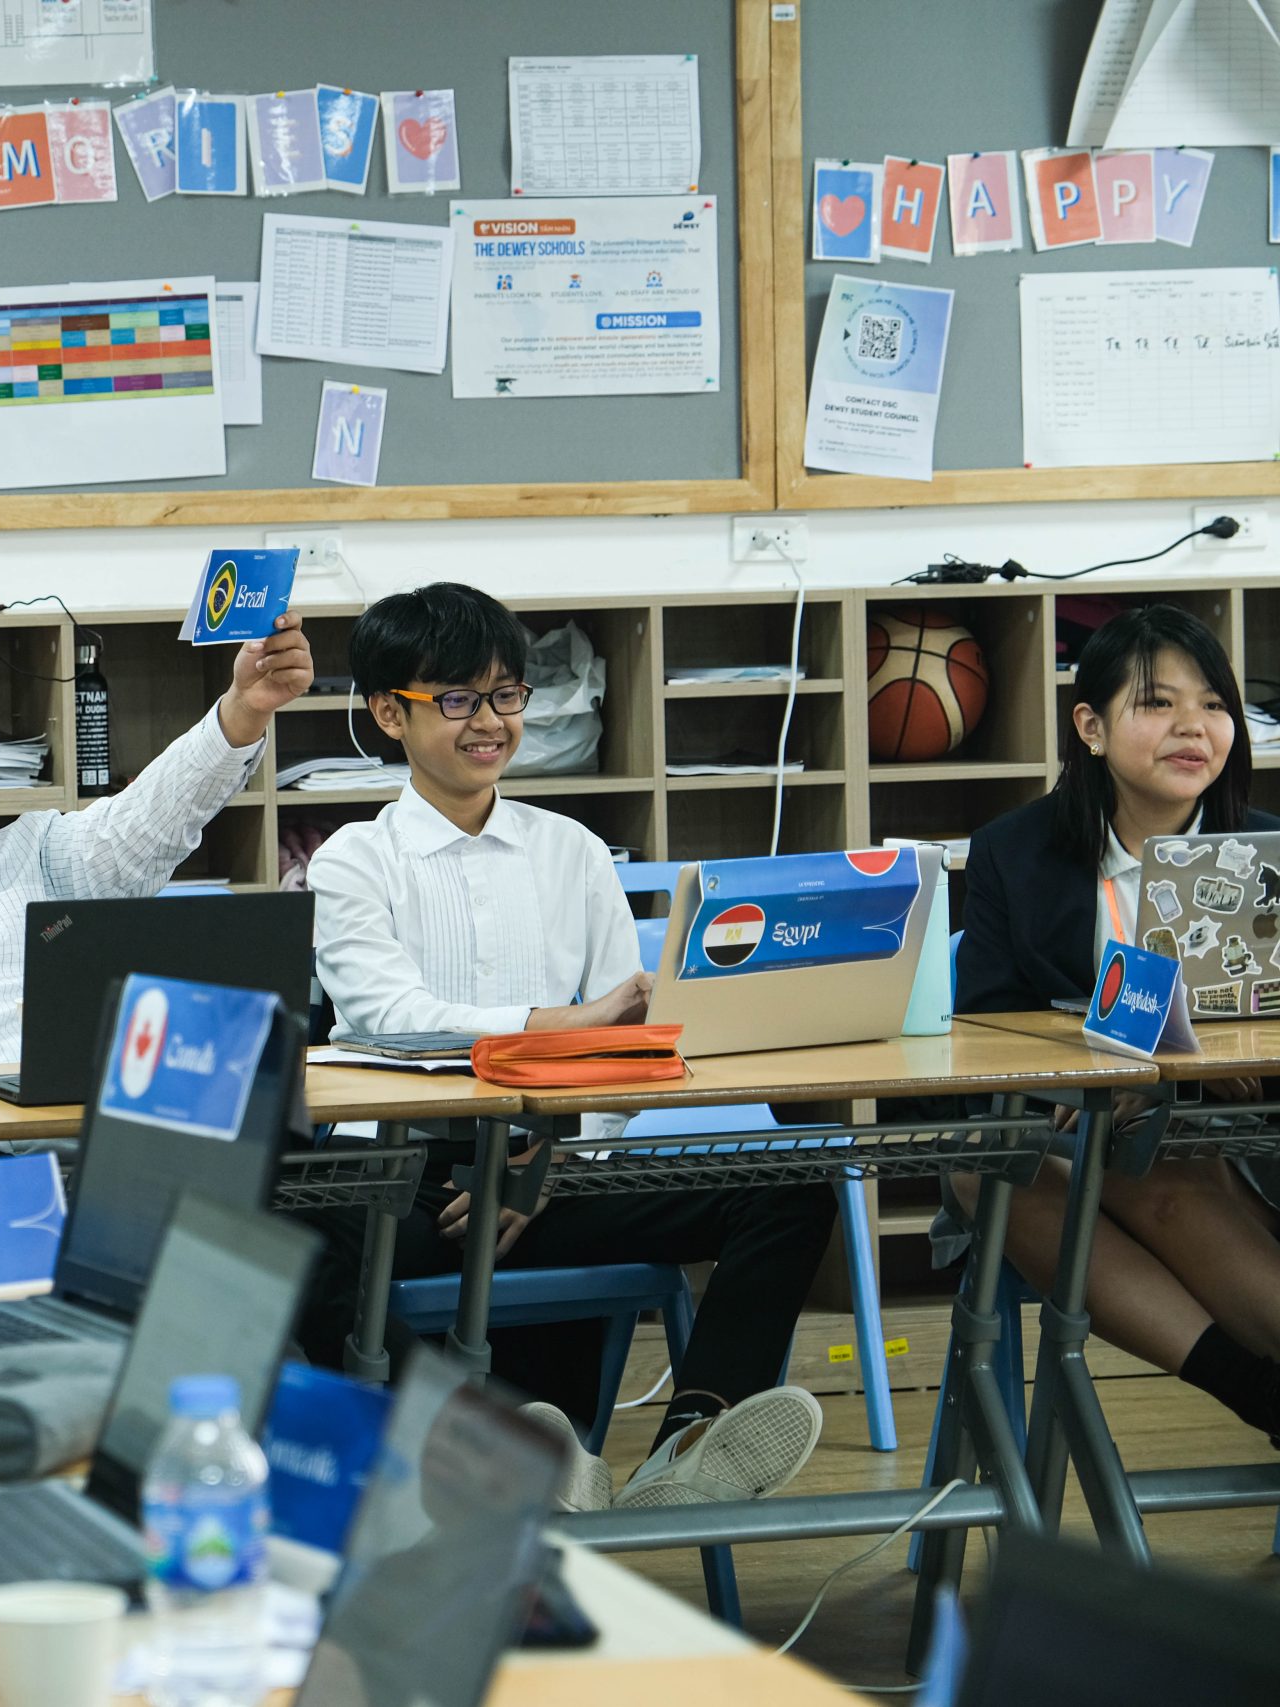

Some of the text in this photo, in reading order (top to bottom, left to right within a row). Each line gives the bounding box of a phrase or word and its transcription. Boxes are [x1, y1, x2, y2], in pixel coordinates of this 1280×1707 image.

[491, 222, 538, 234] VISION
[474, 240, 585, 257] THE DEWEY SCHOOLS
[612, 314, 667, 327] MISSION
[845, 395, 880, 406] CONTACT
[851, 407, 883, 417] STUDENT
[884, 412, 919, 422] COUNCIL
[235, 584, 269, 608] Brazil
[40, 913, 73, 943] ThinkPad
[772, 921, 822, 947] Egypt
